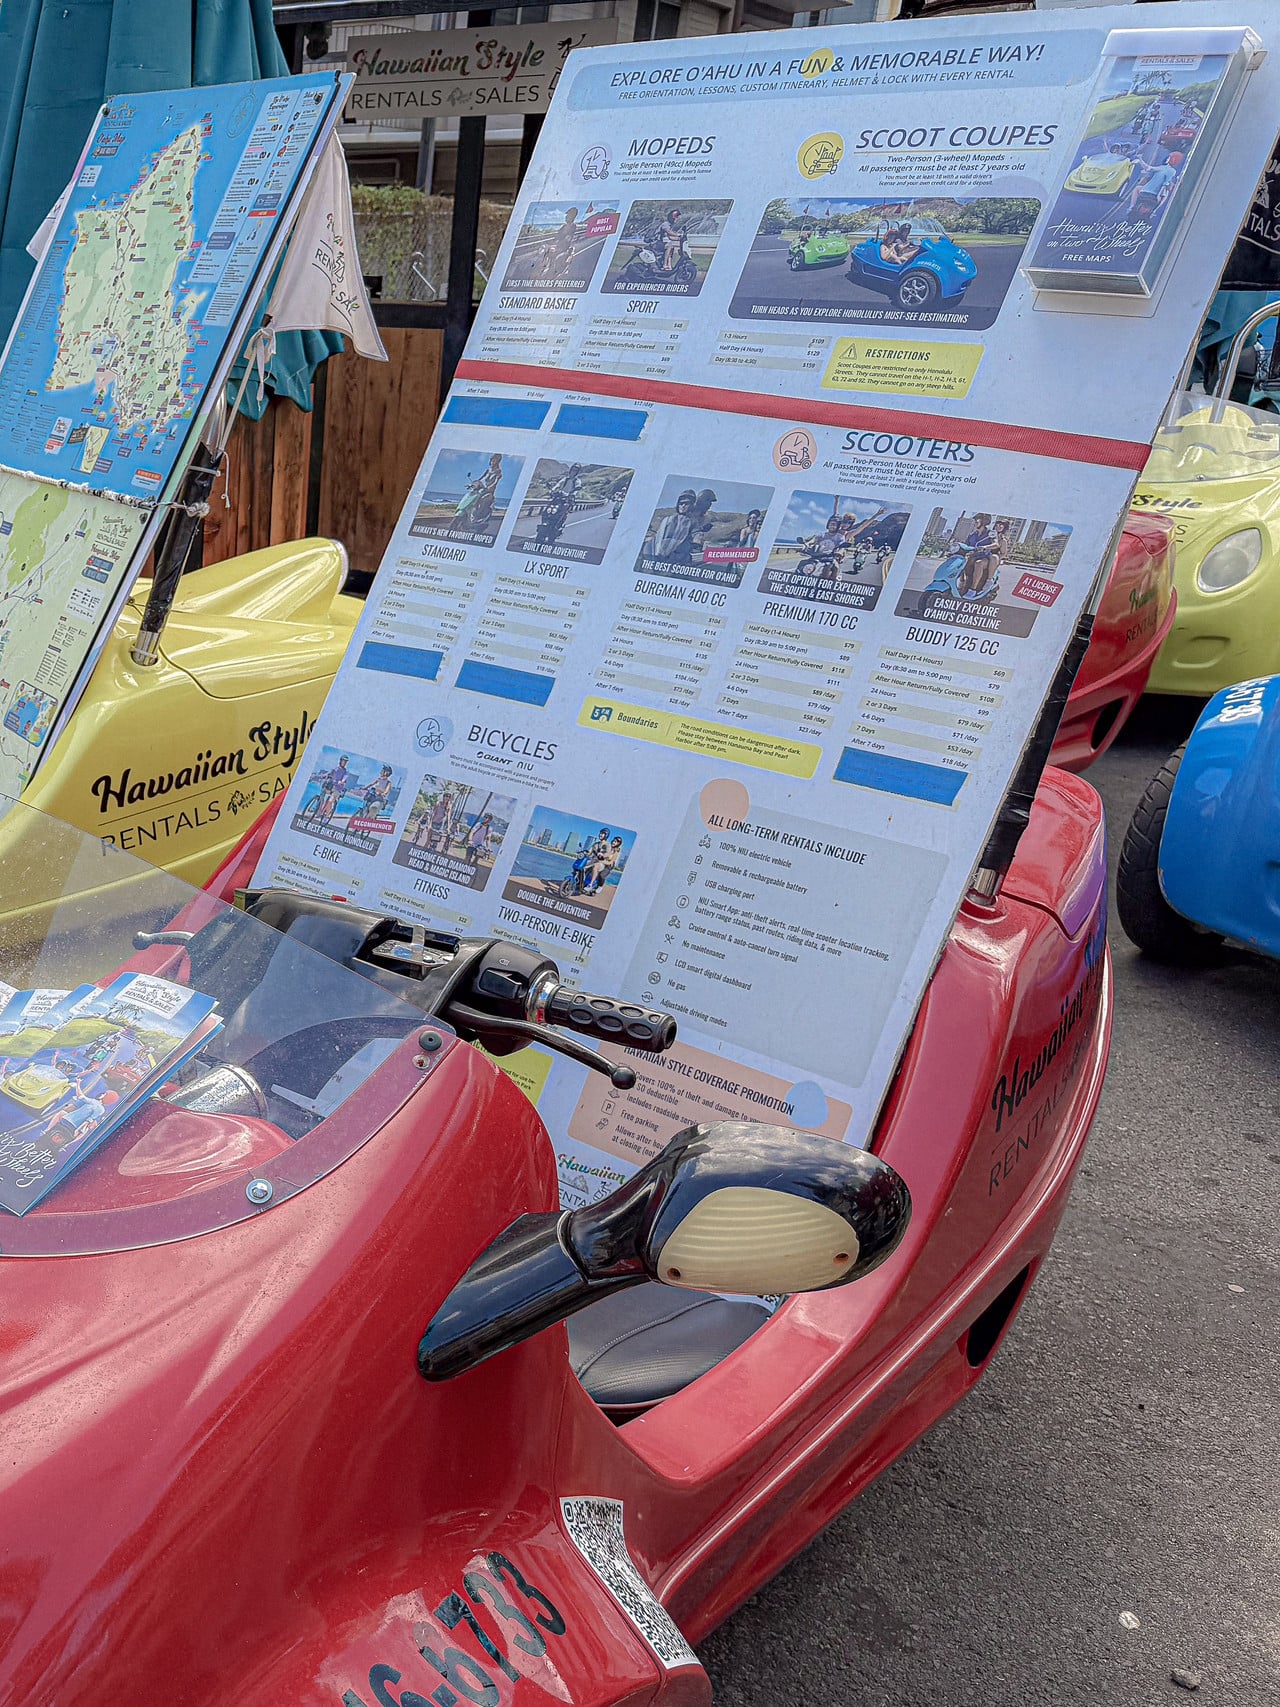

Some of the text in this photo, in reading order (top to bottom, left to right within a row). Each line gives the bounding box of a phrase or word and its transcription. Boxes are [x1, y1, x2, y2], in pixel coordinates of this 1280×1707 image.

[352, 39, 544, 82] Hawaiian Style
[611, 44, 1045, 87] EXPLORE O'AHU IN A FUN & MEMORABLE WAY!
[639, 87, 696, 98] ORIENTATION,
[698, 85, 737, 96] LESSONS,
[740, 83, 777, 92] CUSTOM
[779, 80, 828, 90] ITINERARY,
[831, 77, 870, 87] HELMET
[871, 76, 879, 84] &
[882, 74, 909, 84] LOCK
[911, 73, 937, 82] WITH
[939, 71, 973, 81] EVERY
[975, 70, 1015, 79] RENTAL
[352, 85, 539, 109] RENTALS SALES
[628, 136, 716, 156] MOPEDS
[856, 125, 1058, 149] SCOOT COUPES
[620, 162, 639, 170] Single
[640, 161, 663, 169] Person
[685, 160, 712, 168] Mopeds
[972, 154, 1004, 162] Mopeds
[870, 165, 913, 174] passengers
[979, 163, 986, 171] 7
[986, 164, 1009, 173] years
[499, 297, 577, 310] STANDARD BASKET
[627, 301, 659, 313] SPORT
[751, 305, 767, 314] TURN
[768, 306, 789, 315] HEADS
[790, 306, 798, 315] AS
[800, 307, 813, 316] YOU
[814, 308, 842, 318] EXPLORE
[884, 311, 917, 321] MUST-SEE
[919, 313, 968, 323] DESTINATIONS
[865, 349, 931, 361] RESTRICTIONS
[842, 431, 977, 462] SCOOTERS
[852, 458, 952, 473] Two-Person Motor Scooters
[1132, 495, 1203, 512] Style
[422, 544, 466, 562] STANDARD
[522, 542, 587, 559] BUILT FOR ADVENTURE
[708, 550, 755, 559] RECOMMENDED
[524, 561, 569, 579] LX SPORT
[634, 580, 727, 607] BURGMAN 400 CC
[768, 570, 875, 597] GREAT OPTION FOR EXPLORING
[1023, 577, 1058, 594] A1 LICENSE
[770, 582, 864, 606] THE SOUTH & EAST SHORES
[1018, 587, 1051, 603] ACCEPTED
[763, 602, 858, 630] PREMIUM 170 CC
[934, 598, 1000, 617] EASILY EXPLORE
[956, 614, 1001, 630] COASTLINE
[906, 626, 1000, 655] BUDDY 125 CC
[617, 712, 658, 729] Boundaries
[468, 725, 558, 761] BICYCLES
[483, 753, 513, 766] GIANT
[91, 750, 248, 812] Hawaiian
[101, 801, 221, 856] RENTALS
[354, 820, 392, 831] RECOMMENDED
[708, 815, 867, 865] ALL LONG-TERM RENTALS INCLUDE
[313, 845, 342, 863] E-BIKE
[719, 842, 792, 868] 100% NIU electric vehicle
[414, 879, 450, 900] FITNESS
[705, 880, 755, 900] USB charging port
[517, 889, 591, 920] DOUBLE THE ADVENTURE
[498, 906, 596, 948] TWO-PERSON E-BIKE
[992, 987, 1084, 1133] Hawaiian
[624, 1046, 795, 1115] HAWAIIAN STYLE COVERAGE PROMOTION
[621, 1110, 659, 1132] Free parking
[558, 1154, 625, 1184] Hawaiian
